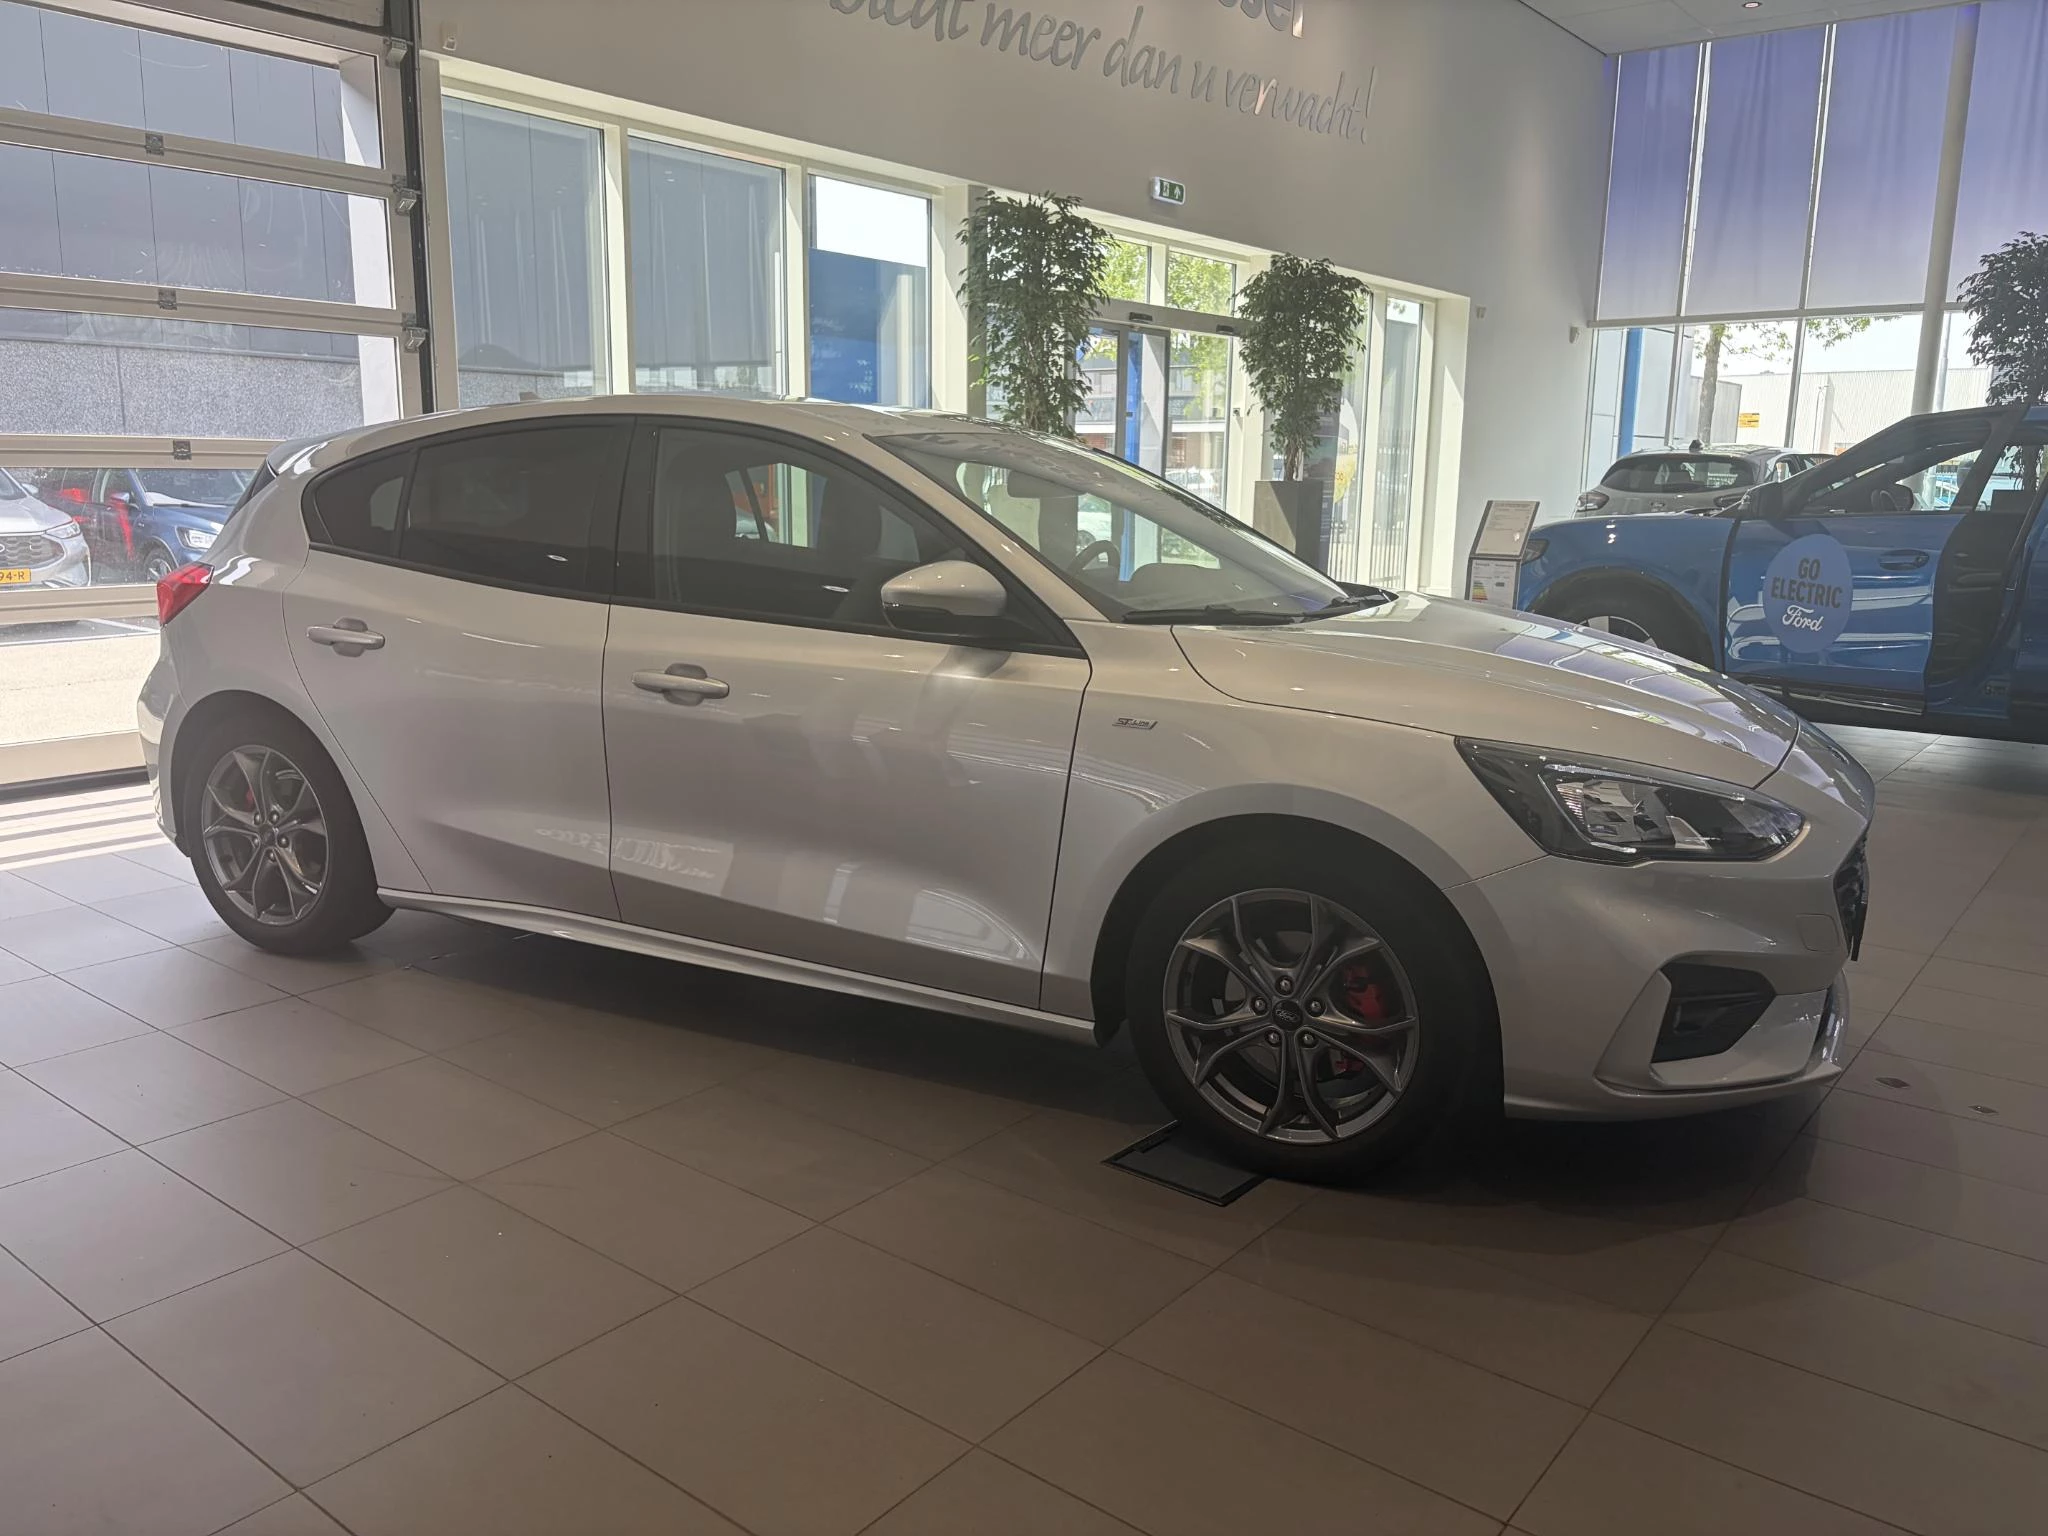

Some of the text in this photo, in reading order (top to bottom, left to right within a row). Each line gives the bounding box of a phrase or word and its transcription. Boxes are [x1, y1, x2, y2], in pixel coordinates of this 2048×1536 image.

[980, 3, 1101, 70] meer
[1103, 5, 1182, 93] dan
[1191, 60, 1218, 102] u
[1798, 558, 1821, 580] GO
[1771, 576, 1843, 609] ELECTRIC
[1782, 604, 1824, 631] Ford
